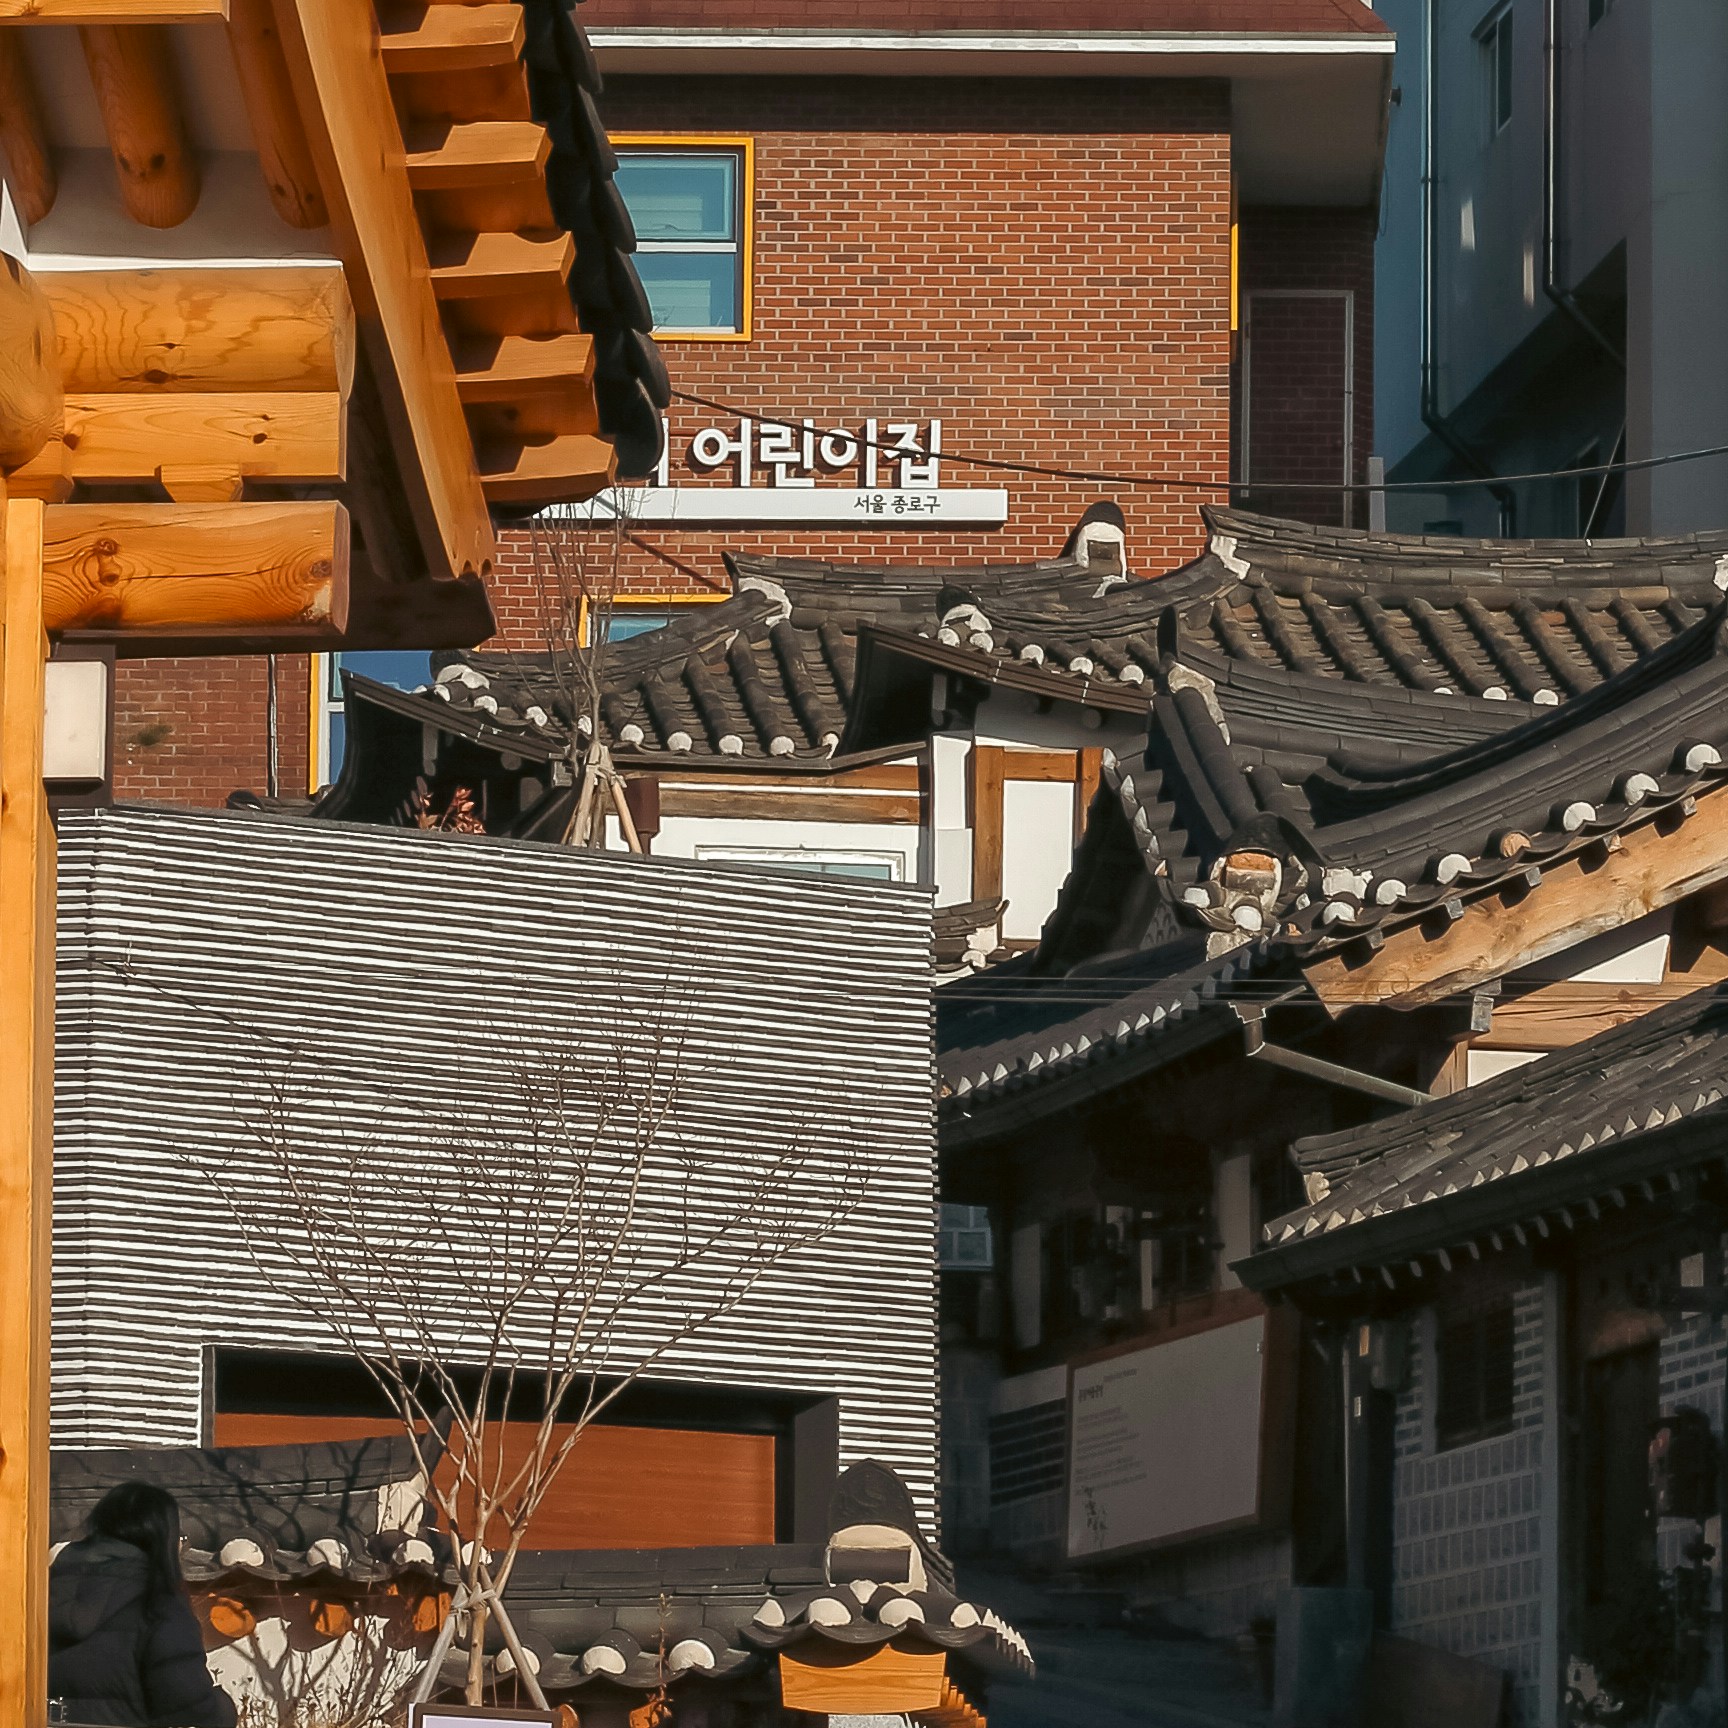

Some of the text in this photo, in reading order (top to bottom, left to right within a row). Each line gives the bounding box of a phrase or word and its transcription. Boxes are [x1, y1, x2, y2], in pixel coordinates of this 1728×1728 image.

[692, 417, 942, 488] 어린이집
[853, 494, 941, 514] 서울 종로구
